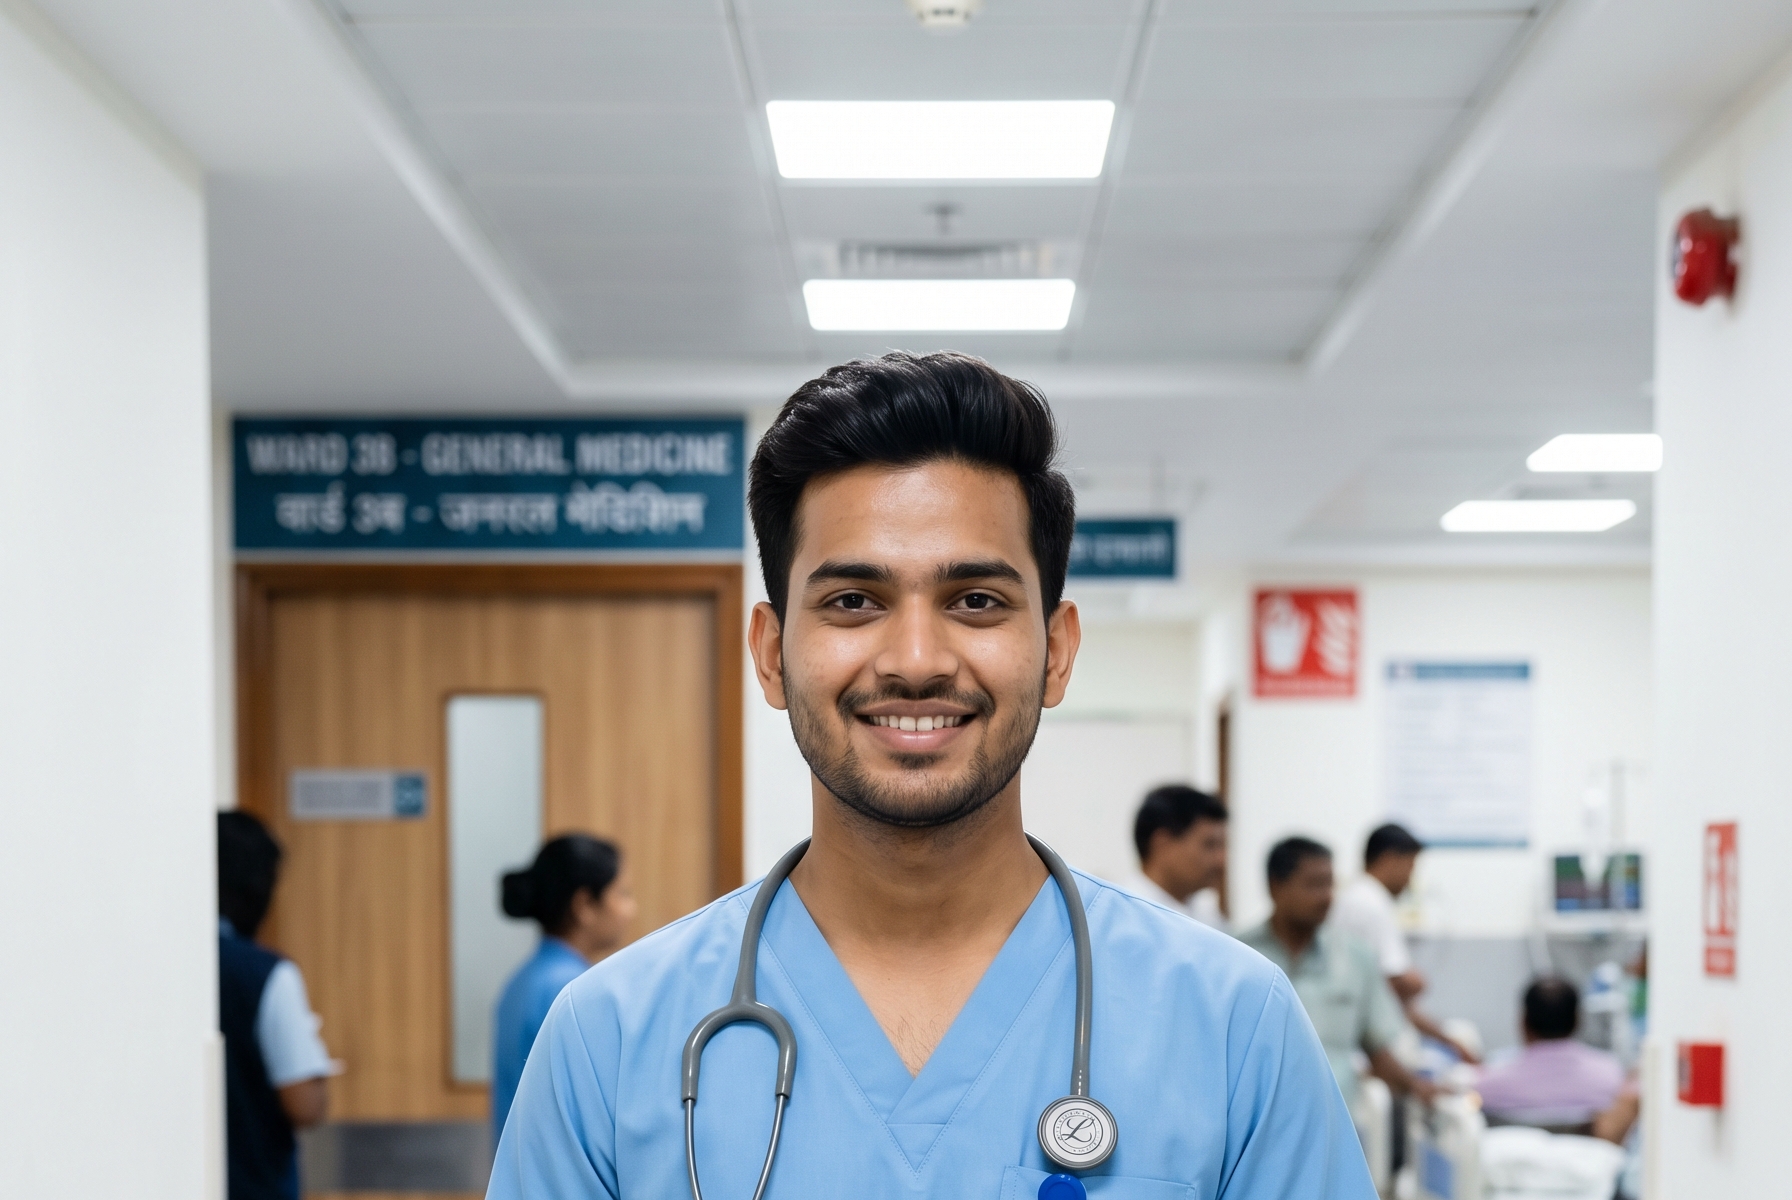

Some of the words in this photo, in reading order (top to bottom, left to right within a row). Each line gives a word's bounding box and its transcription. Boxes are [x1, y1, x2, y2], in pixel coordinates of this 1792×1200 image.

[247, 433, 348, 474] WARD
[421, 433, 570, 475] GENERAL
[575, 433, 731, 475] MEDICINE
